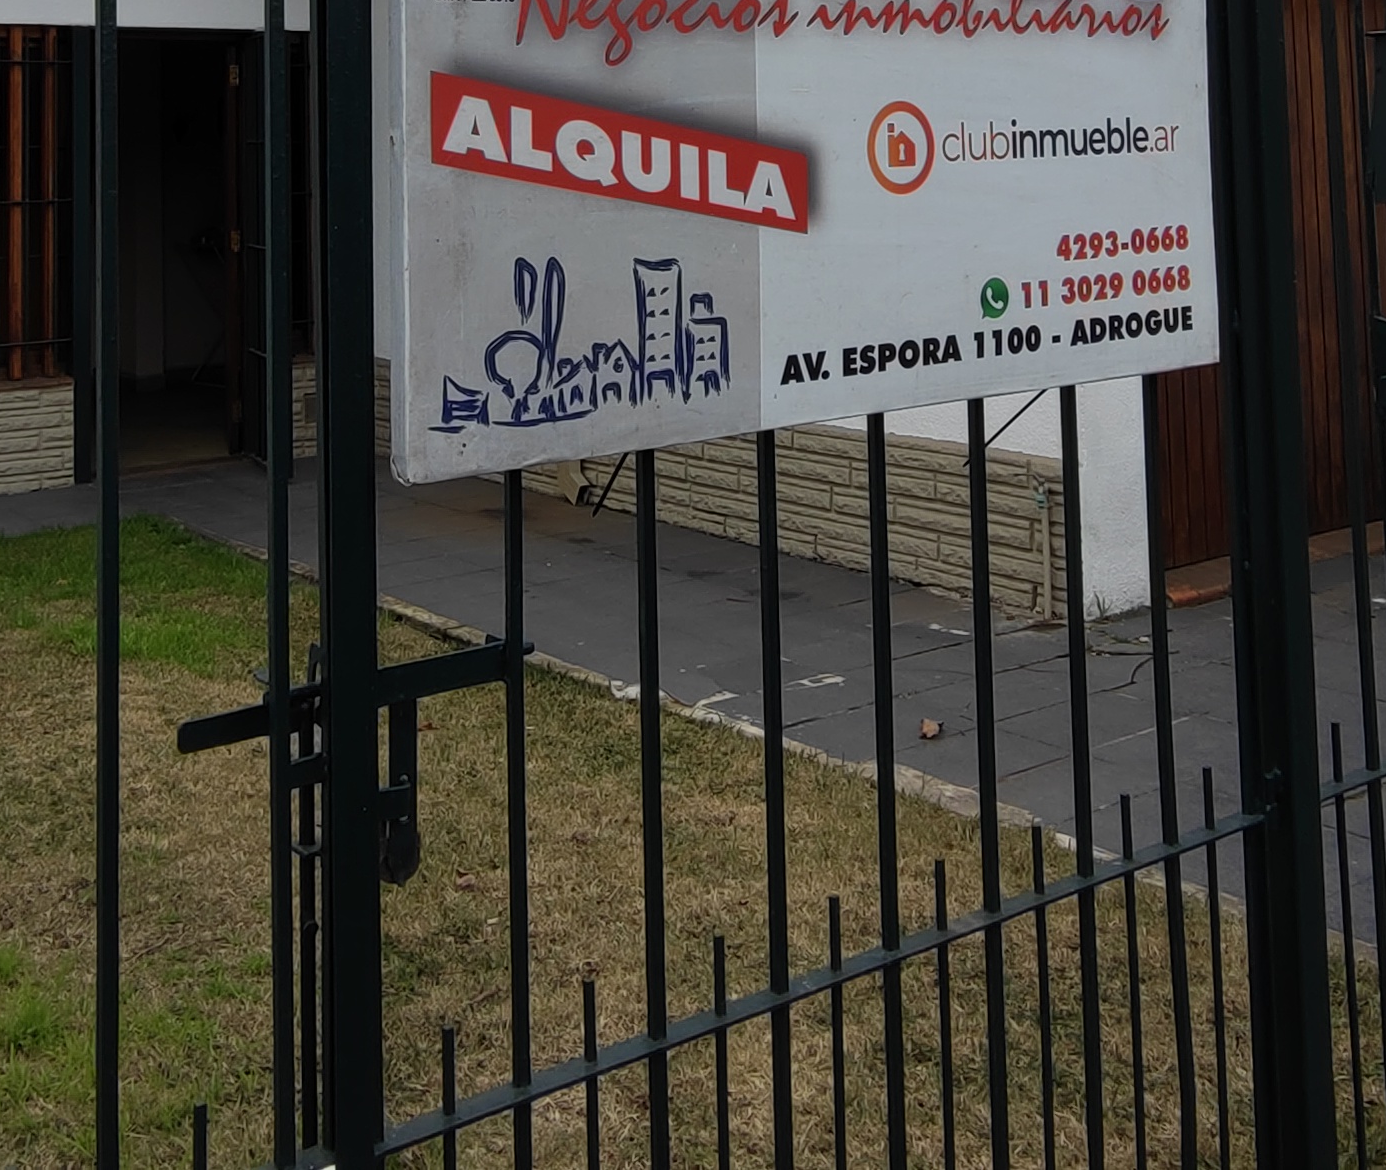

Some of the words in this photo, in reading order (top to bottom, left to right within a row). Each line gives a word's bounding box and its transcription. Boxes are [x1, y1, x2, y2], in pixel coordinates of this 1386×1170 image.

[442, 94, 797, 221] ALQUILA
[941, 116, 1181, 162] clubinmueble.ar
[1056, 224, 1190, 262] 4293-0668
[1021, 279, 1050, 309] 11
[1061, 272, 1125, 305] 3029
[1131, 264, 1192, 297] 0668
[779, 350, 831, 386] AV.
[842, 334, 963, 378] ESPORA
[973, 324, 1042, 359] 1100
[1070, 305, 1194, 347] ADROGUE
